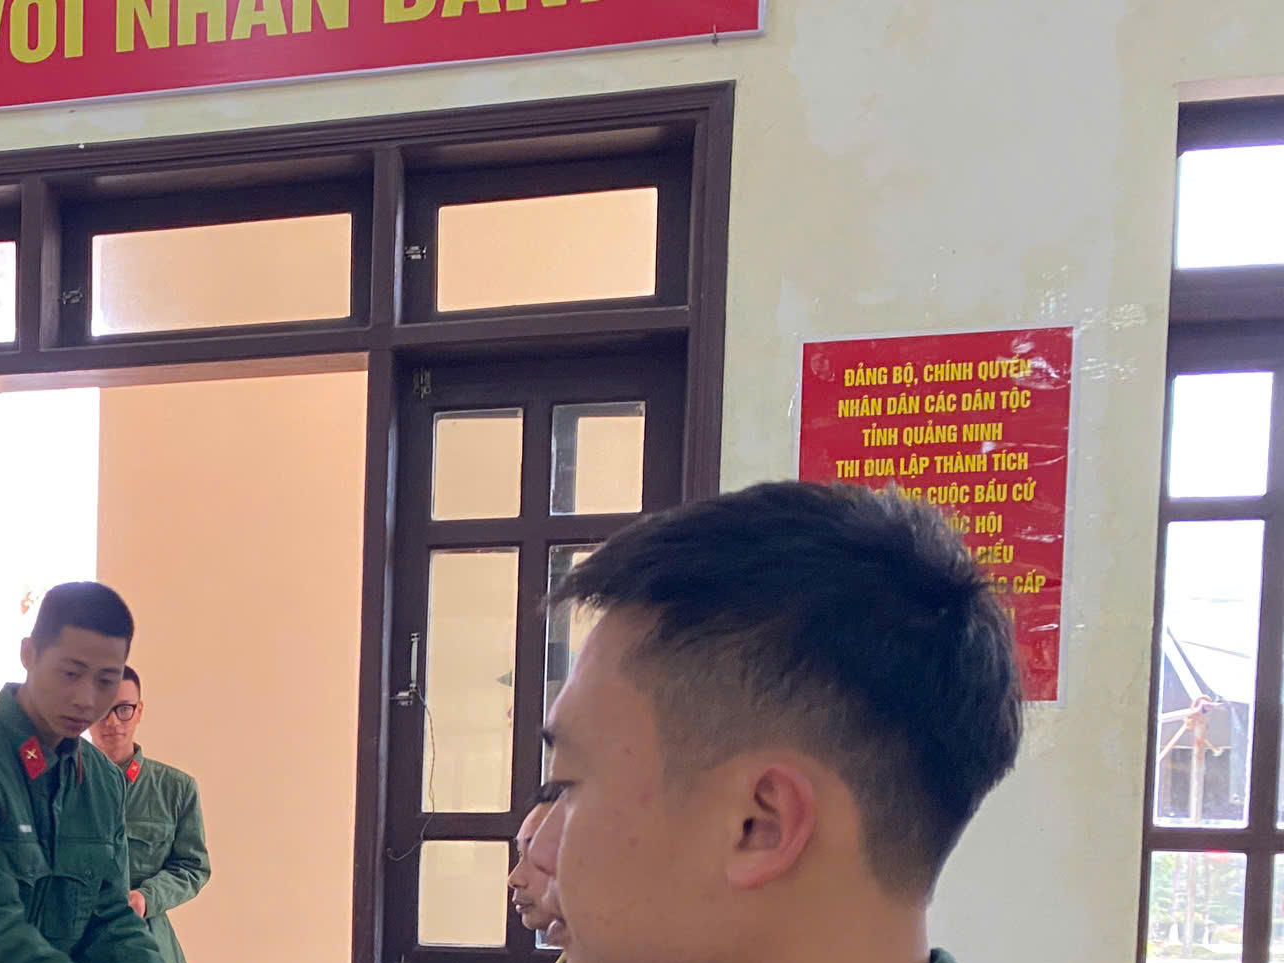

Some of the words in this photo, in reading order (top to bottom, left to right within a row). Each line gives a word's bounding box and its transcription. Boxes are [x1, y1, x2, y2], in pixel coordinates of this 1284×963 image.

[844, 362, 888, 387] ĐẢNG
[892, 361, 918, 388] BỘ,
[923, 358, 973, 382] CHÍNH
[837, 394, 883, 418] NHÂN
[886, 392, 920, 415] DÂN
[924, 390, 957, 413] CÁC
[961, 388, 995, 411] DÂN
[1000, 386, 1032, 413] TỘC
[862, 422, 898, 447] TỈNH
[902, 419, 958, 447] QUẢNG
[962, 422, 1003, 442] NINH
[835, 459, 860, 478] THI
[864, 458, 895, 477] ĐUA
[899, 452, 930, 479] LẬP
[934, 450, 988, 474] THÀNH
[991, 449, 1029, 471] TÍCH
[926, 482, 970, 507] CUỘC
[1012, 476, 1037, 501] CỬ
[975, 511, 1003, 537] HỘI
[1012, 568, 1047, 593] CẤP
